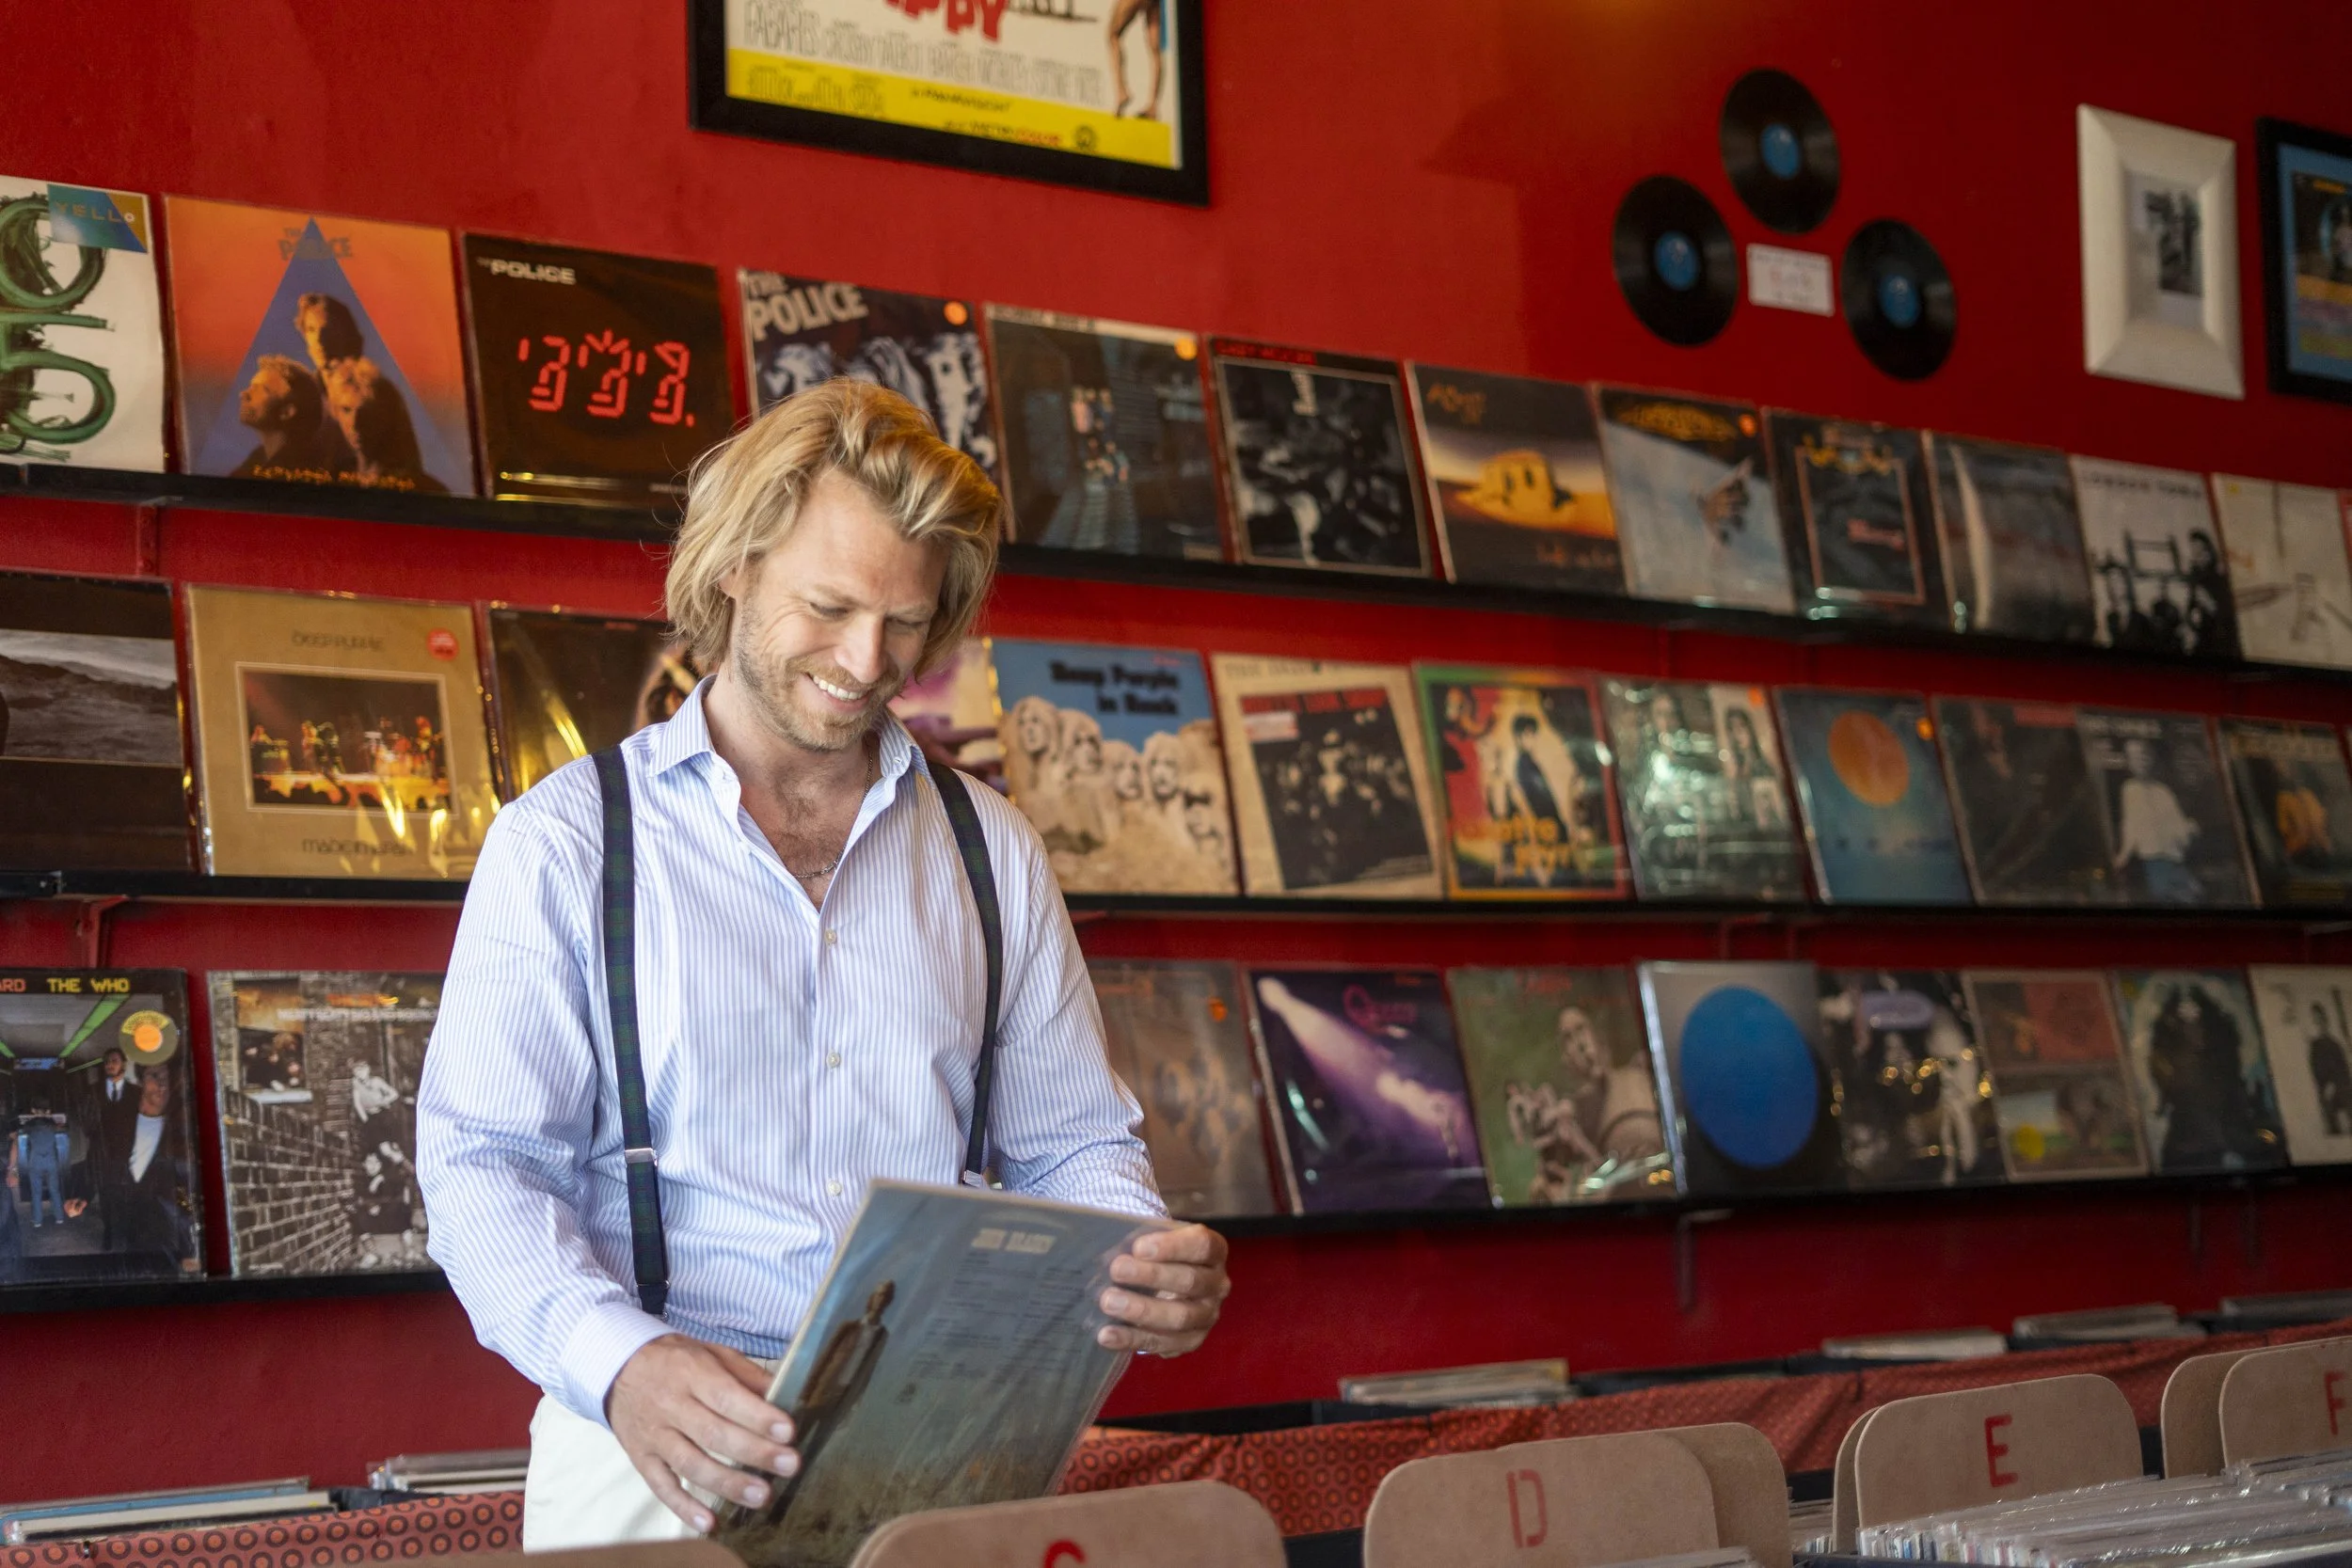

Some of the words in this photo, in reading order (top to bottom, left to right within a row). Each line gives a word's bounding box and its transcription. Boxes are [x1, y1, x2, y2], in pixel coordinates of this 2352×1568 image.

[53, 199, 135, 224] YELLO
[490, 259, 577, 285] POLICE
[749, 281, 868, 341] POLICE
[0, 977, 26, 993] RD
[47, 977, 82, 993] THE
[89, 977, 131, 993] WHO
[2324, 1370, 2348, 1436] F
[1984, 1414, 2019, 1488] E
[1506, 1468, 1549, 1549] D
